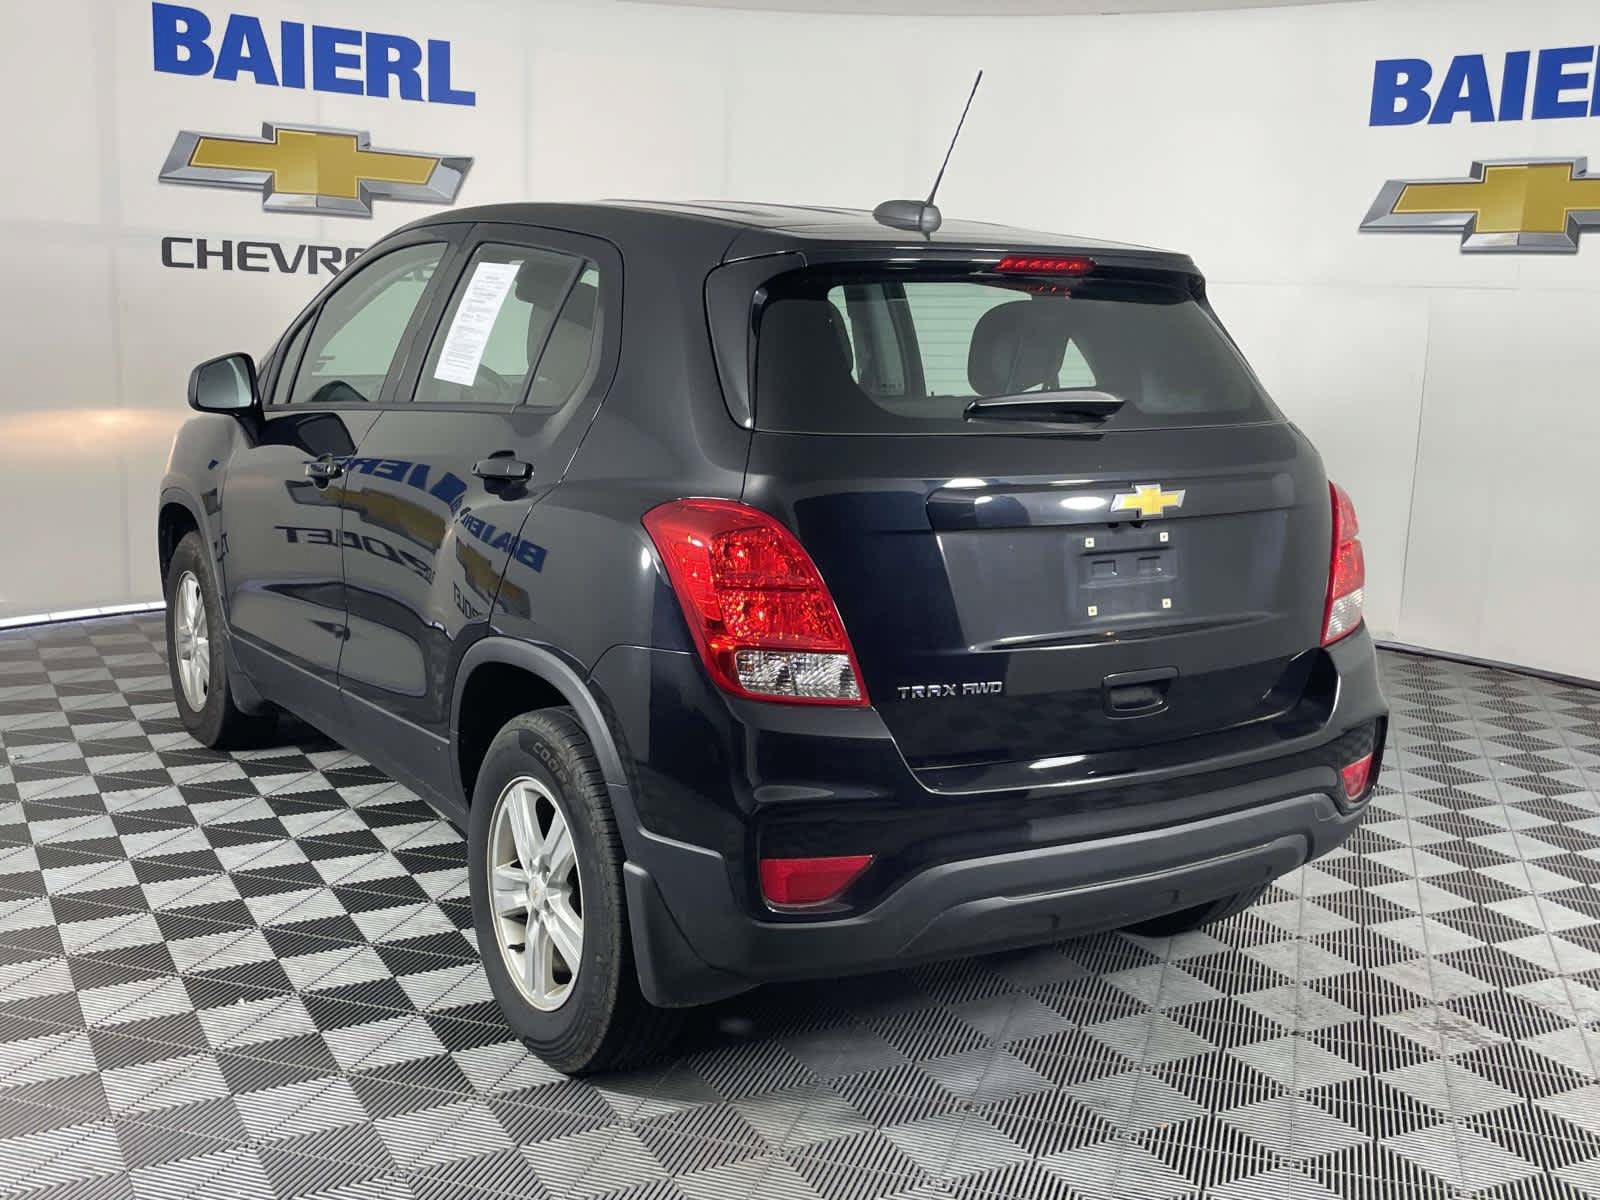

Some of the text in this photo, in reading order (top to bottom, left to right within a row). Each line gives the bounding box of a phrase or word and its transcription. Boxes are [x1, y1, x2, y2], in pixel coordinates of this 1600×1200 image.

[152, 2, 476, 106] BAIERL
[1369, 45, 1600, 126] BAIE
[897, 680, 1003, 700] TRAX AWD
